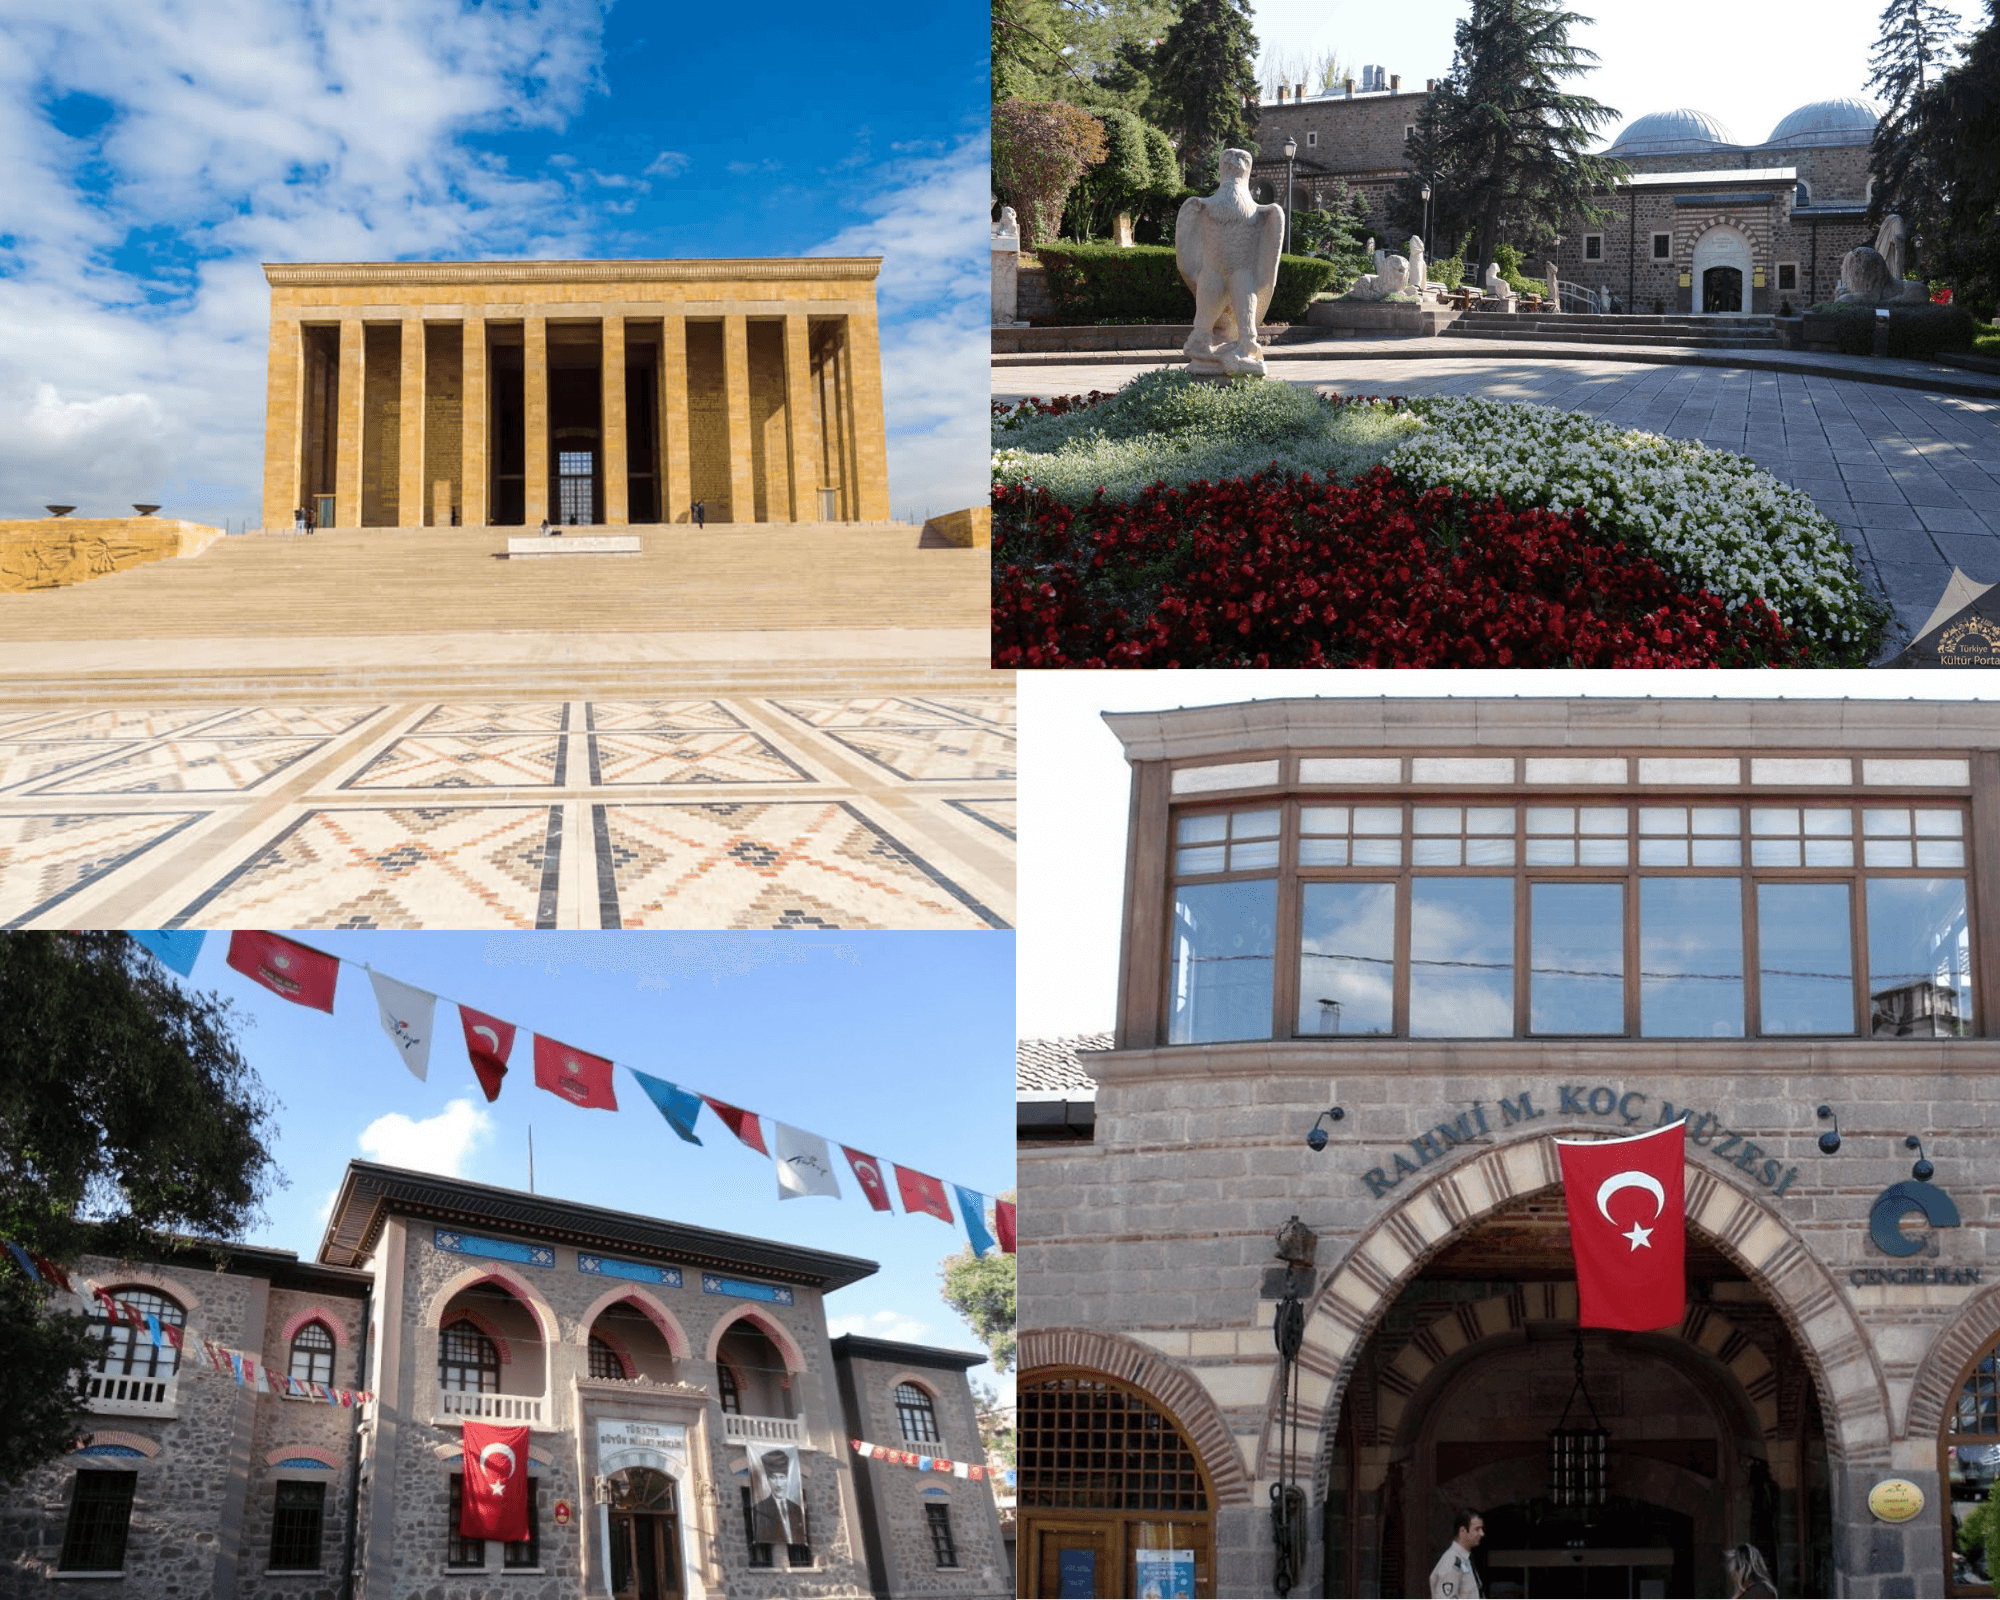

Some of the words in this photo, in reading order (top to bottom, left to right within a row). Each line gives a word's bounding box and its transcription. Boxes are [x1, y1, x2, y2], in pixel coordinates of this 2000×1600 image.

[1361, 1101, 1492, 1199] RAHMİ
[1498, 1091, 1545, 1127] M.
[1558, 1085, 1647, 1126] KOÇ
